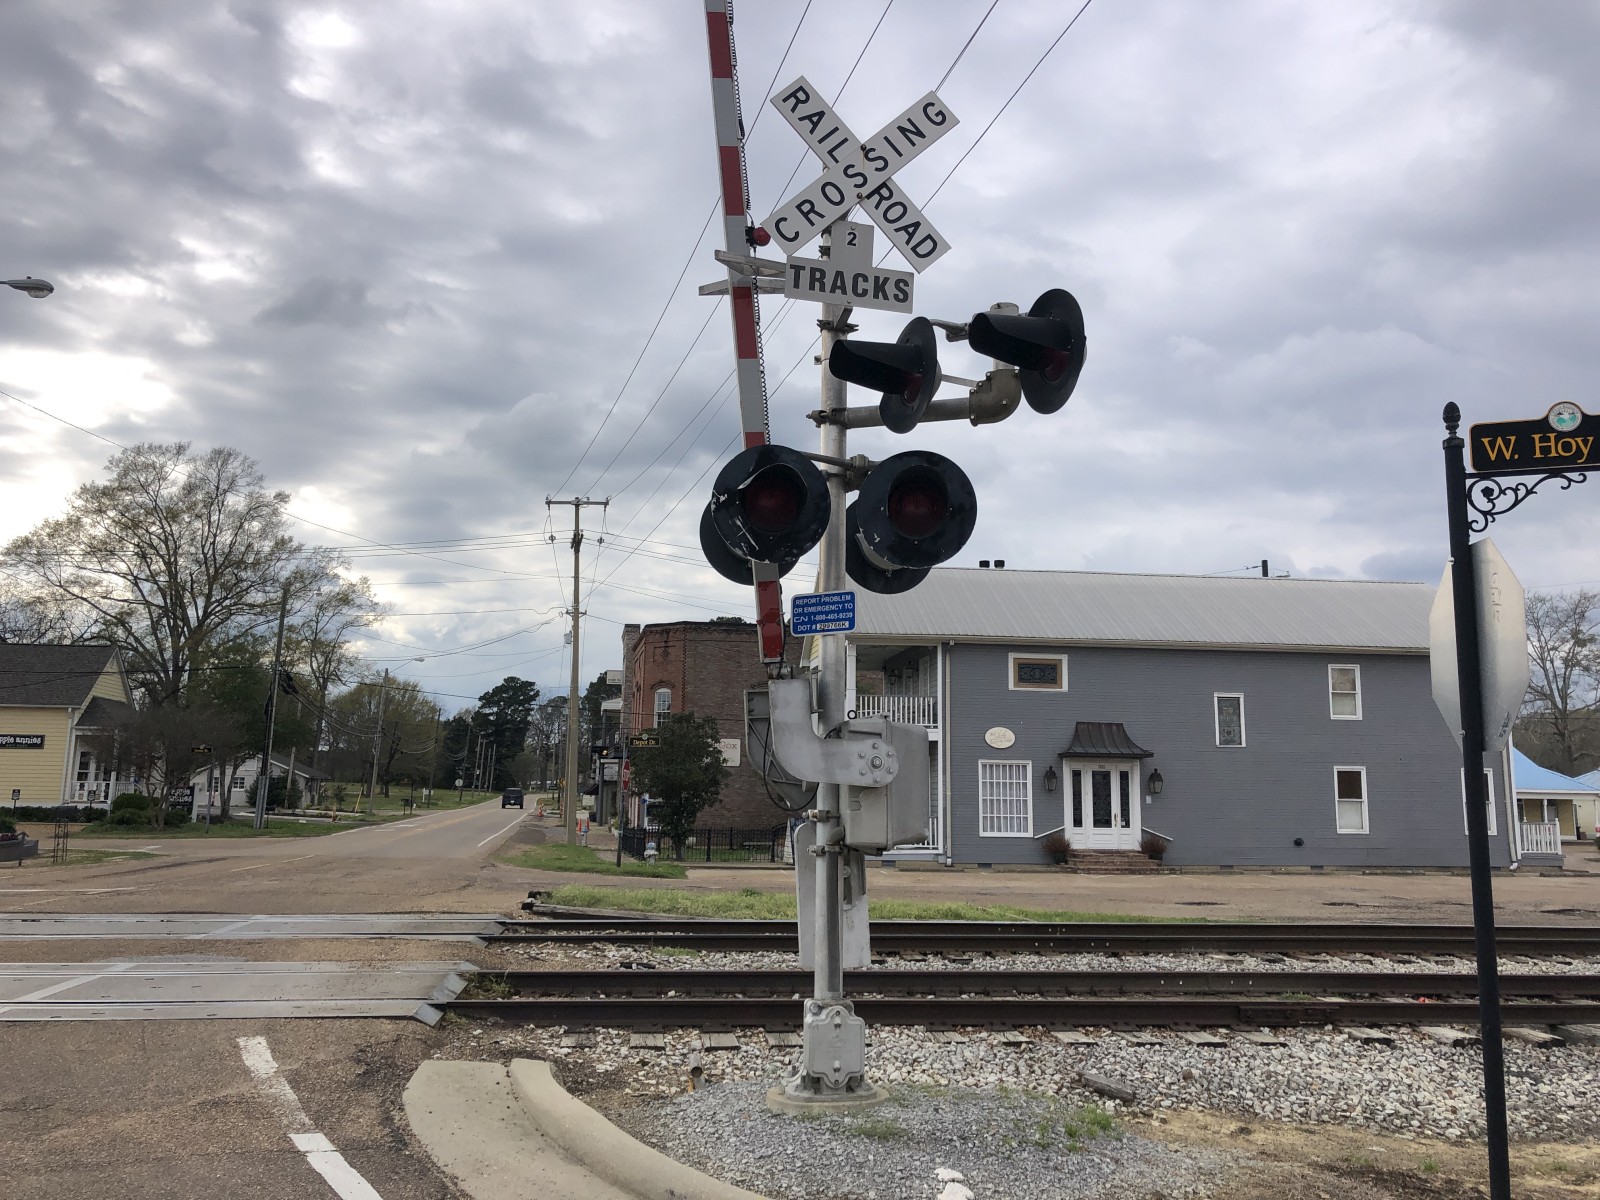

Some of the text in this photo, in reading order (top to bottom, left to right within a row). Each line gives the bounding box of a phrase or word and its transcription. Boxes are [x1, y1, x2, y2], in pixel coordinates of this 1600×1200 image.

[774, 102, 947, 243] CROSSING
[781, 85, 938, 259] RAIL ROAD
[846, 231, 858, 247] 2
[789, 264, 910, 303] TRACKS
[1481, 433, 1594, 463] W. Hoy
[795, 594, 851, 606] REPORT PROBLEM
[803, 603, 843, 613] EMERGENCY
